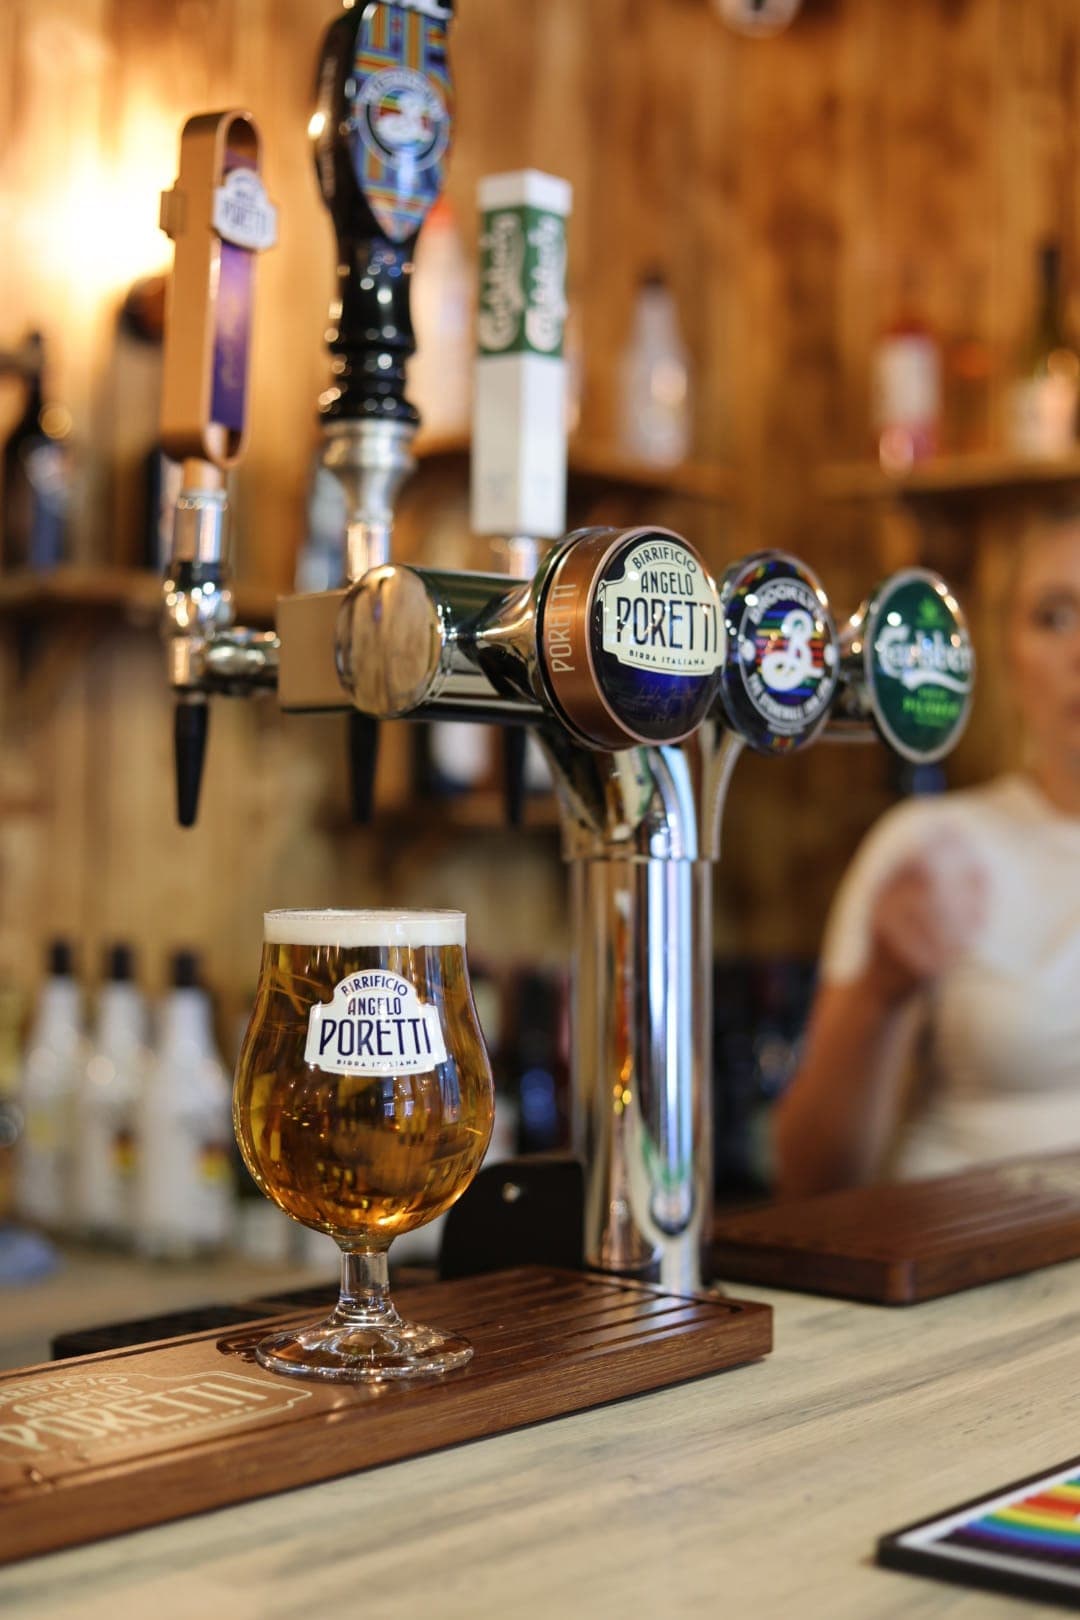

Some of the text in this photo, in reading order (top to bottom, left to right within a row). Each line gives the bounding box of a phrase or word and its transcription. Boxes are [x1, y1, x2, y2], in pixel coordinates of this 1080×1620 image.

[631, 546, 698, 574] BIRRIFICIO
[640, 570, 694, 596] ANGELO
[547, 583, 577, 673] PORETTI
[616, 596, 718, 654] PORETTI
[629, 649, 706, 667] BIRRA ITALIANA
[340, 975, 408, 997] BIRRIFICIO
[347, 997, 402, 1016] ANGELO
[318, 1017, 432, 1057] PORETTI
[371, 1059, 418, 1069] ITLIANA
